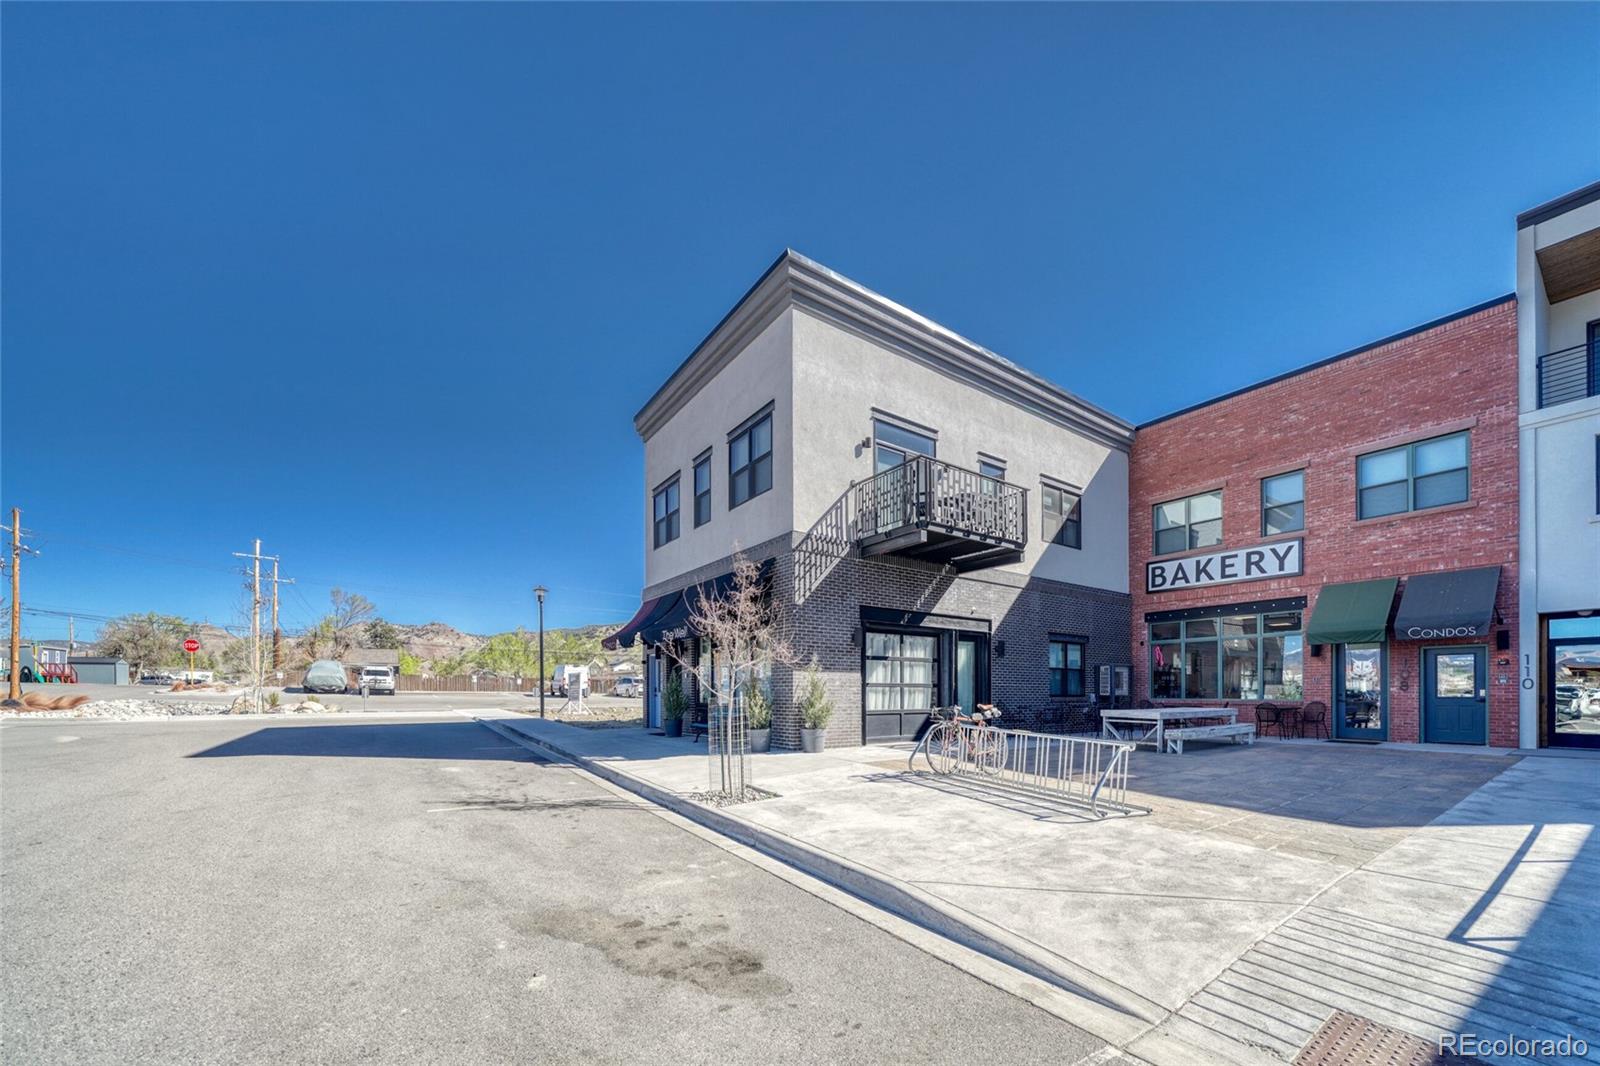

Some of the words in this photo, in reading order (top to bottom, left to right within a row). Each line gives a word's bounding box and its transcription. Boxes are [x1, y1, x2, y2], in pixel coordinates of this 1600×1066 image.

[1151, 545, 1295, 588] BAKERY
[1407, 626, 1476, 639] CONDOS
[1522, 654, 1534, 690] 110
